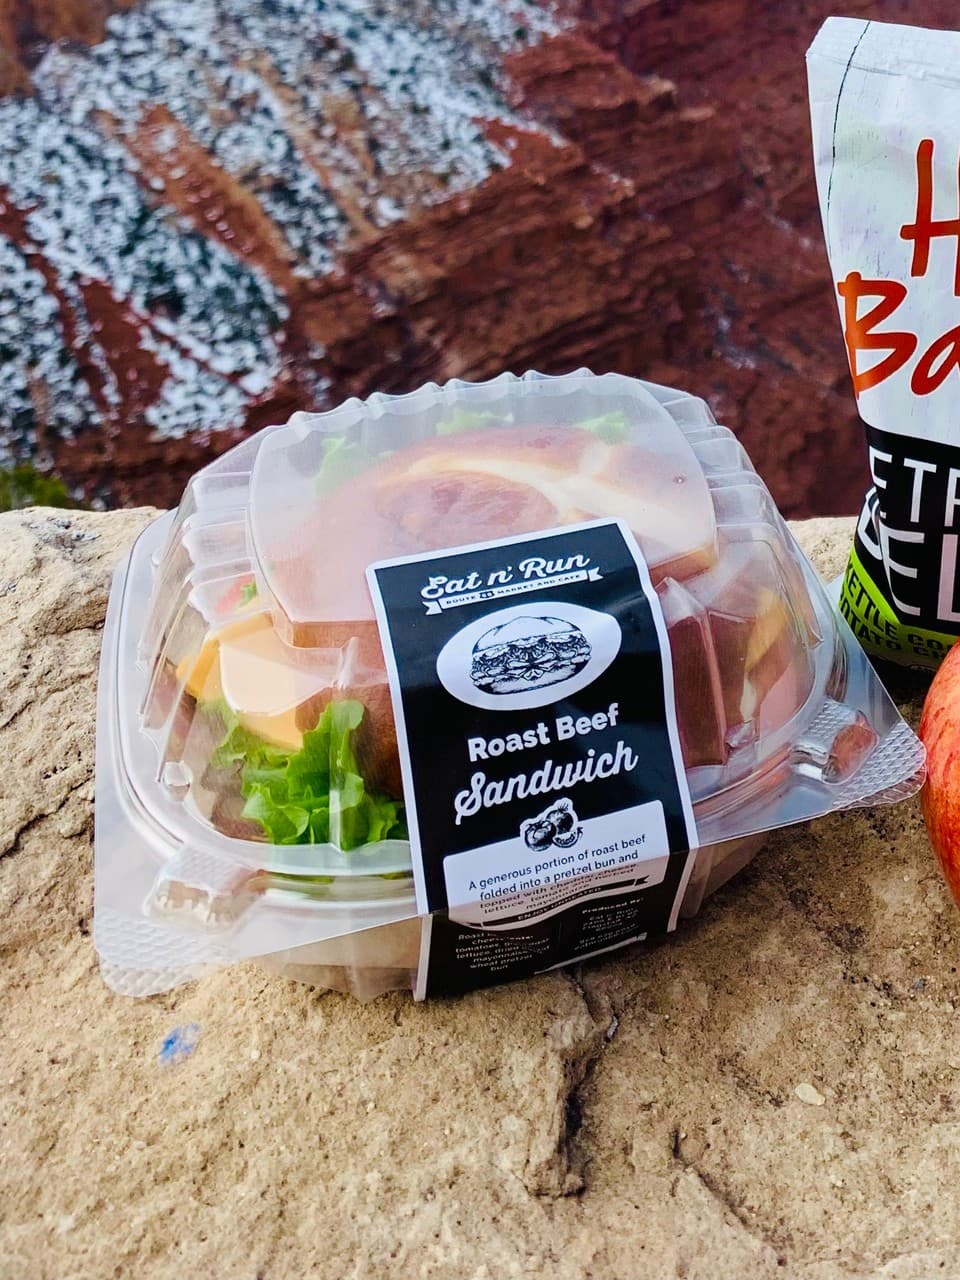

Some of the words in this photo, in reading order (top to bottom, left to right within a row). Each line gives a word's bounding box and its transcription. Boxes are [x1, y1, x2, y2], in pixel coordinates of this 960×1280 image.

[420, 572, 482, 599] Eat
[487, 566, 513, 586] n'
[518, 554, 590, 579] Run
[467, 722, 550, 762] Roast
[555, 702, 619, 741] Beef
[454, 740, 639, 826] Sandwich
[468, 880, 477, 891] A
[479, 866, 532, 890] generous
[535, 855, 575, 874] portion
[577, 849, 589, 861] of
[591, 842, 619, 857] roast
[621, 834, 646, 849] beef
[480, 882, 517, 902] folded
[520, 875, 541, 891] into
[544, 876, 551, 884] a
[553, 863, 592, 884] pretzel
[594, 857, 616, 870] bun
[618, 850, 639, 864] and
